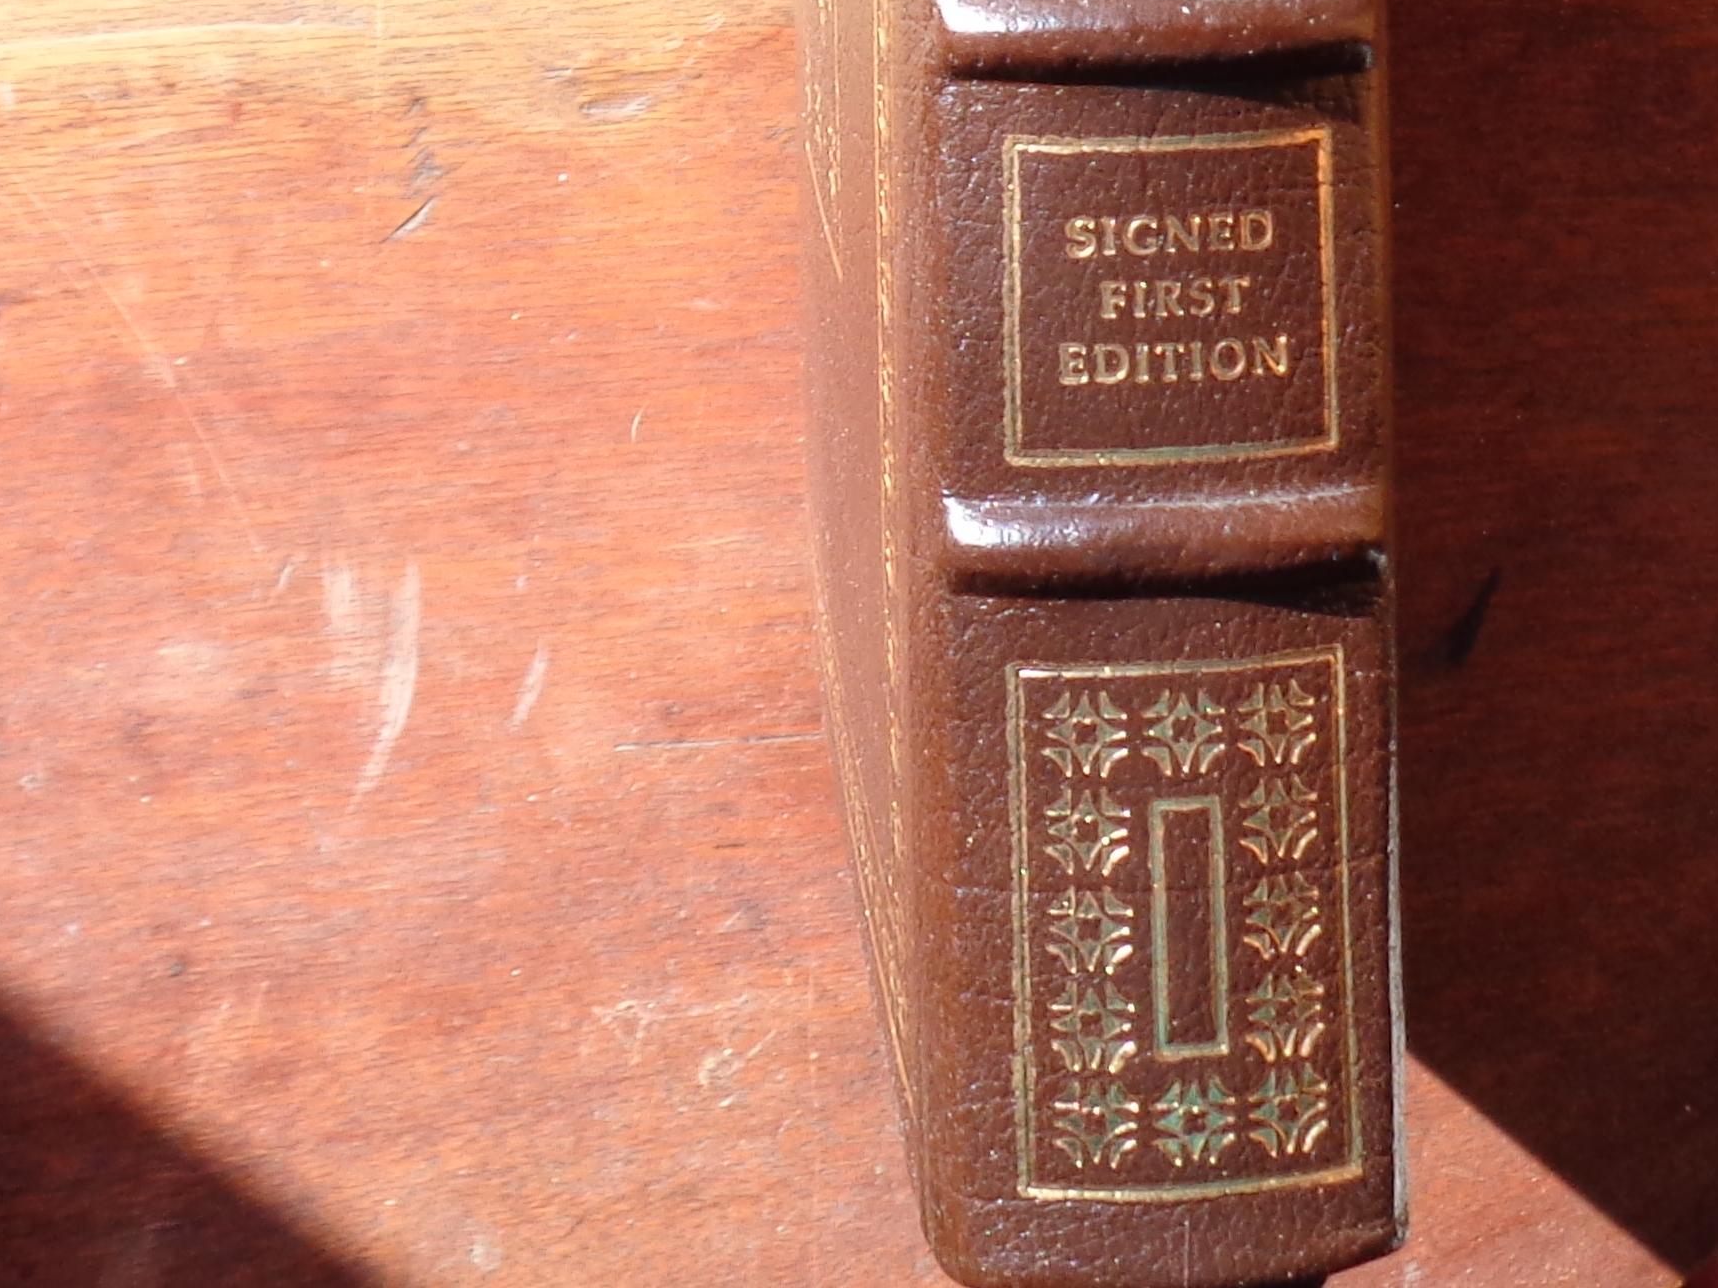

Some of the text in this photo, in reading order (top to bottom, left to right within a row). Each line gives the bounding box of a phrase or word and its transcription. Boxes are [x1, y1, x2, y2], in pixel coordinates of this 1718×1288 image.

[1064, 209, 1275, 260] SIGNED
[1099, 277, 1252, 319] FIRST
[1058, 334, 1289, 386] EDITION
